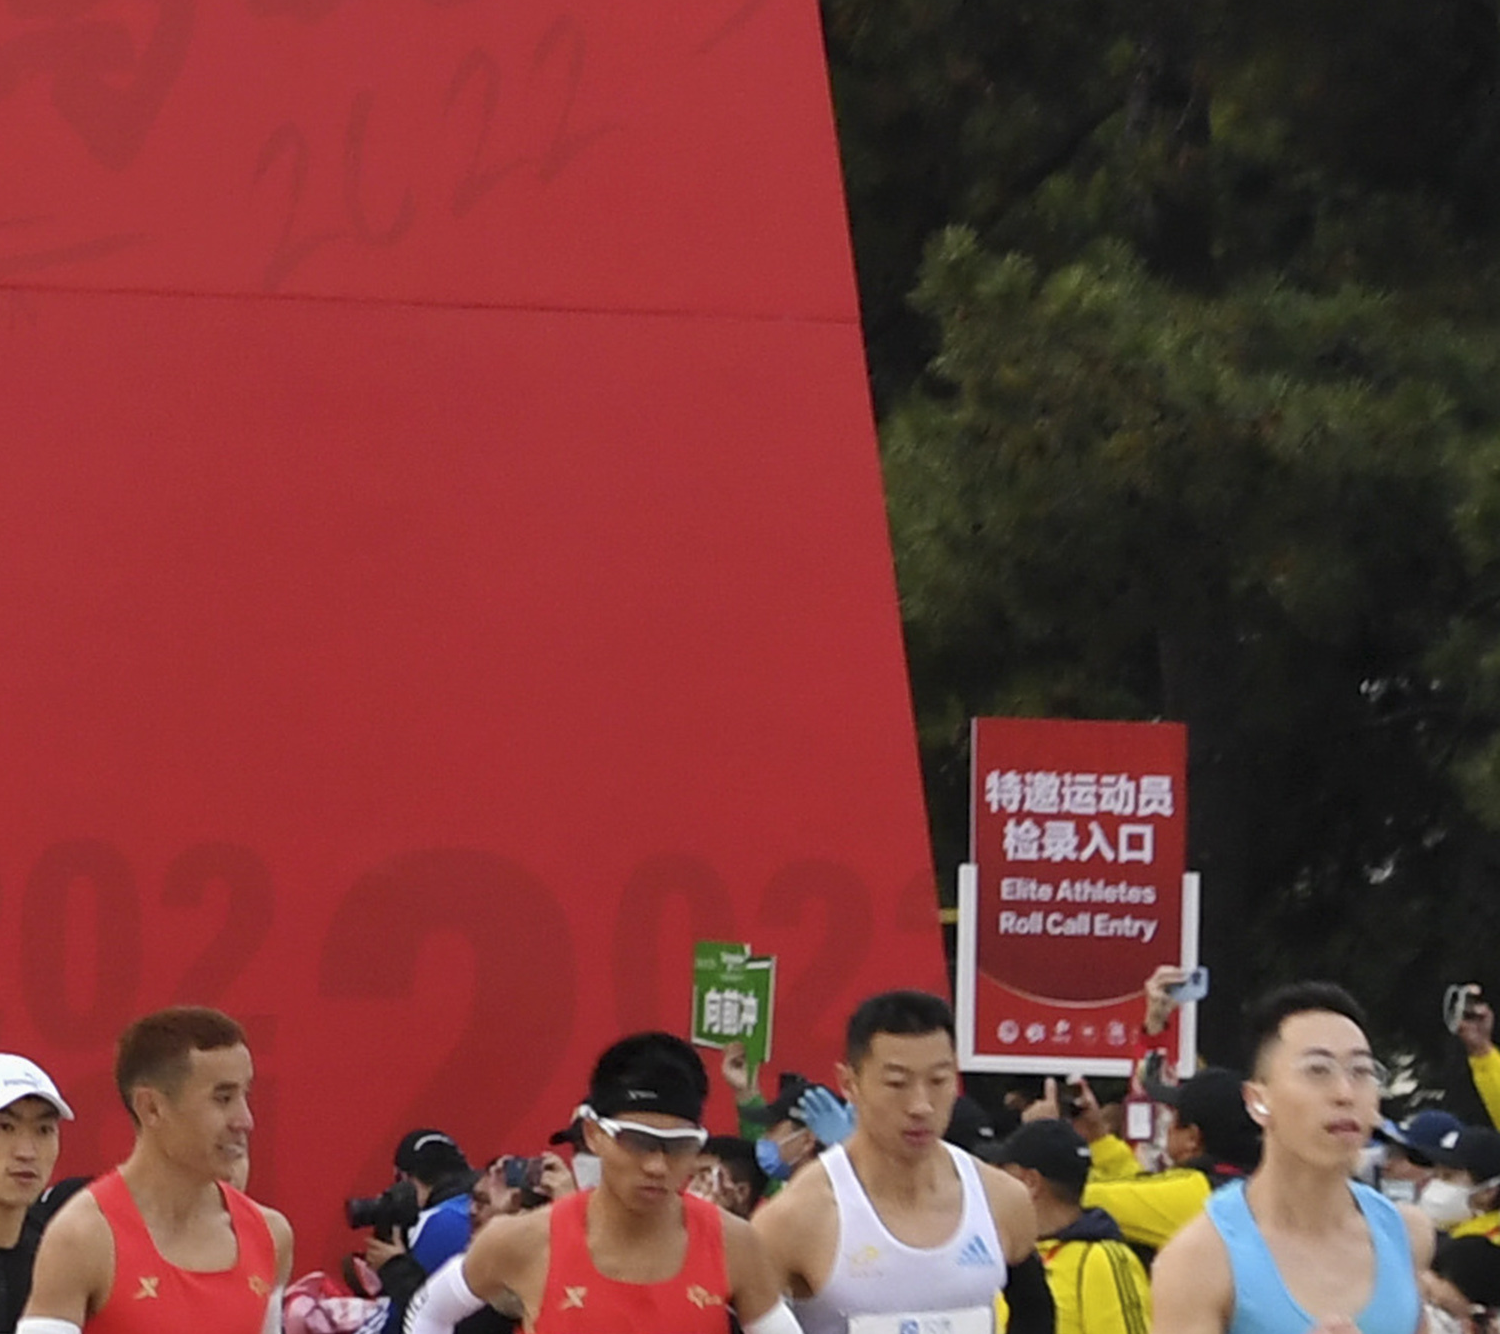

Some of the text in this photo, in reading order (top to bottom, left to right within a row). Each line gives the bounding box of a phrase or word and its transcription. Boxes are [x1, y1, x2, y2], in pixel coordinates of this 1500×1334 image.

[985, 769, 1174, 817] 特邀运动员
[1003, 819, 1155, 864] 检录入口
[1000, 877, 1156, 905] Elite Athletes
[999, 911, 1157, 943] Roll Call Entry
